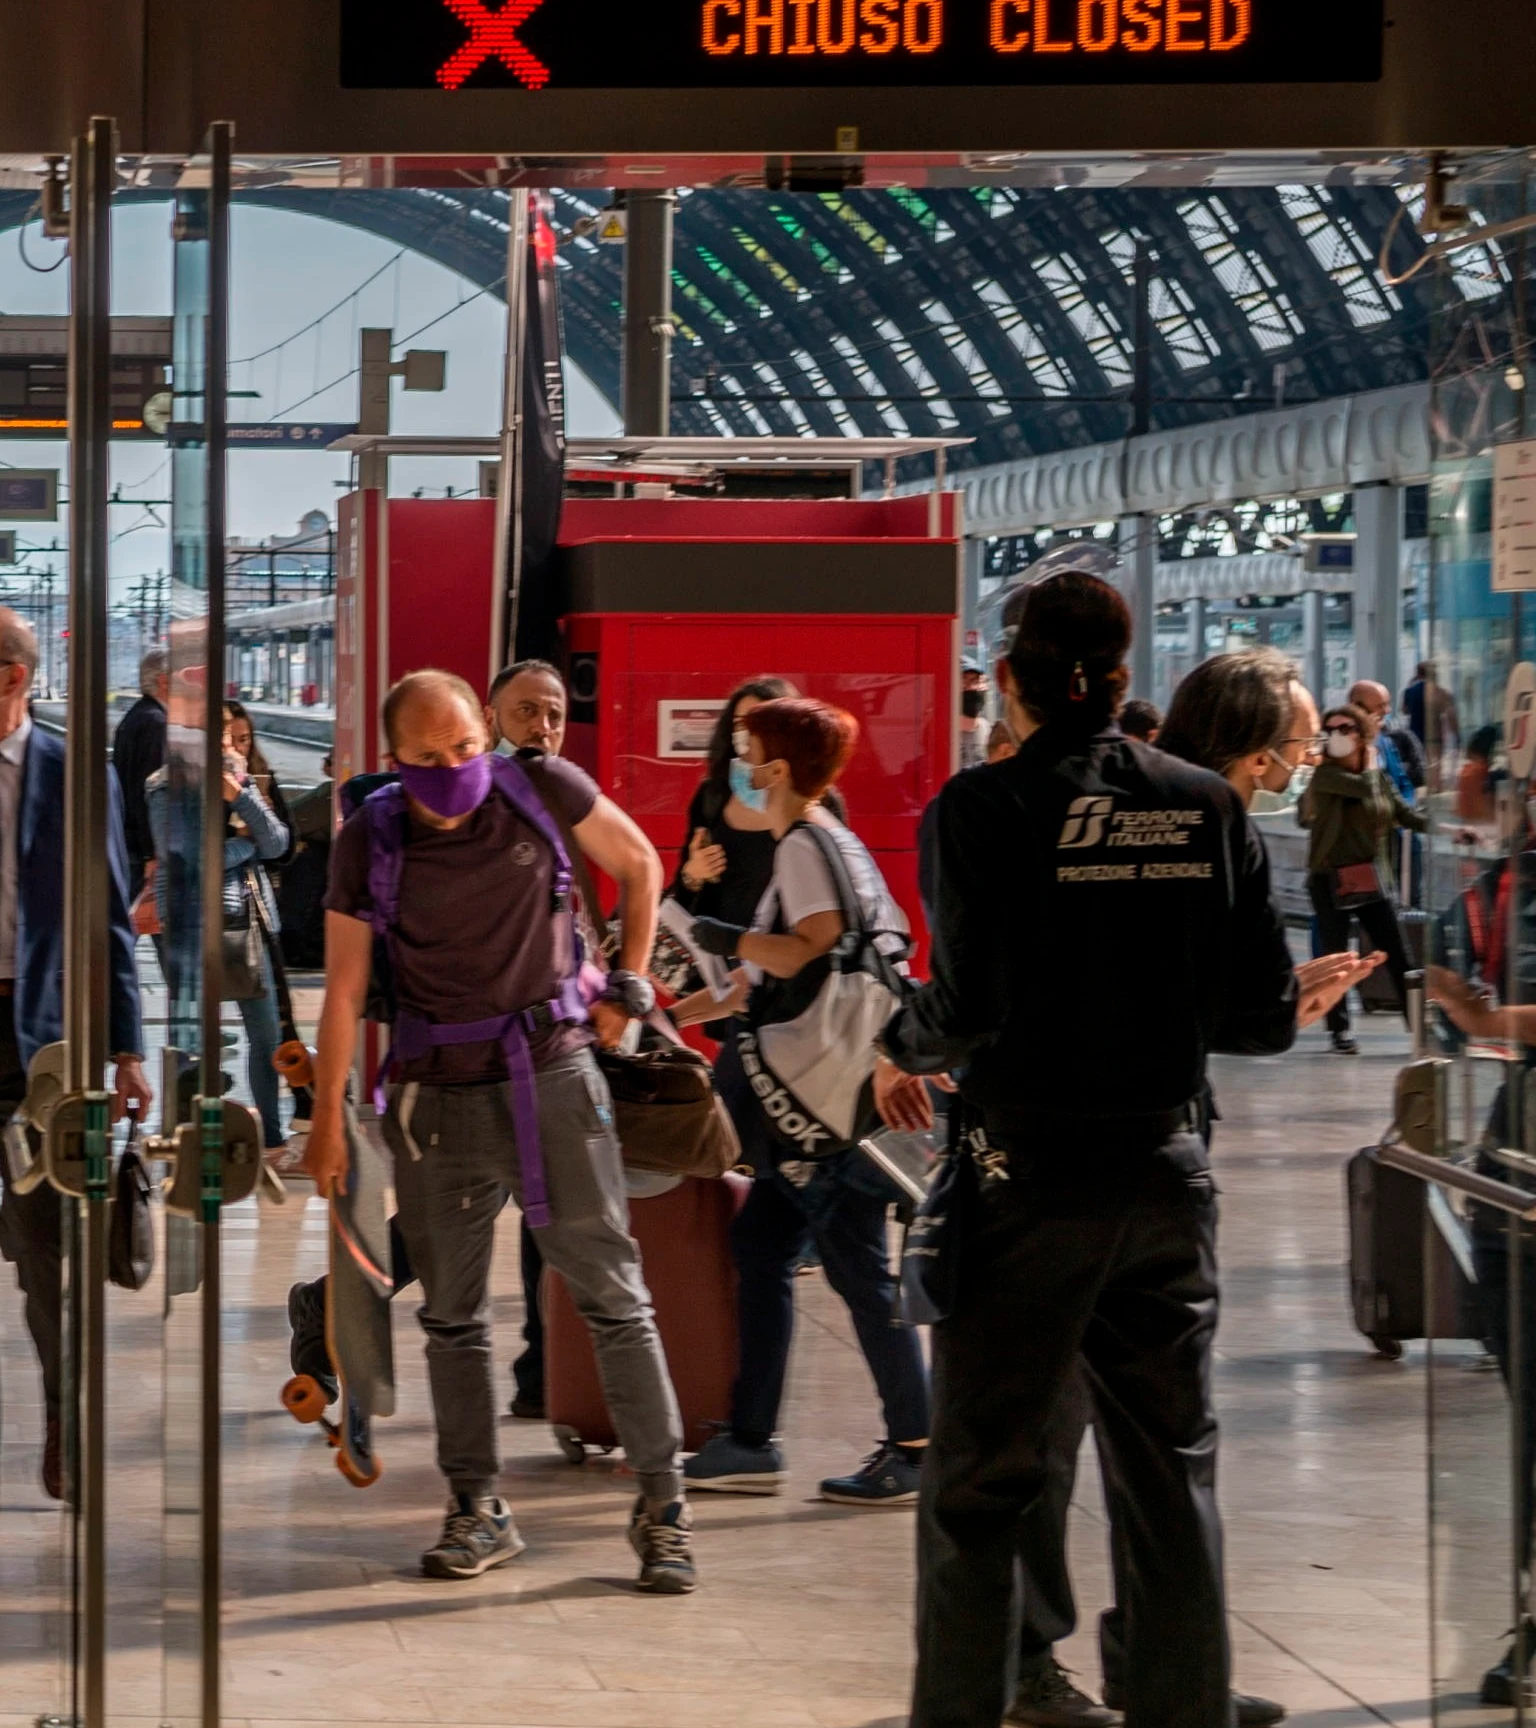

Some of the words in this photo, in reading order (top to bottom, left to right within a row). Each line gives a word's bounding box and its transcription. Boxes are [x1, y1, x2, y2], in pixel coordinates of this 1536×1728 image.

[700, 0, 944, 55] CHIUSO
[989, 0, 1251, 52] CLOSED
[1112, 810, 1204, 825] FERROVIE
[1106, 831, 1190, 846] ITALIANE
